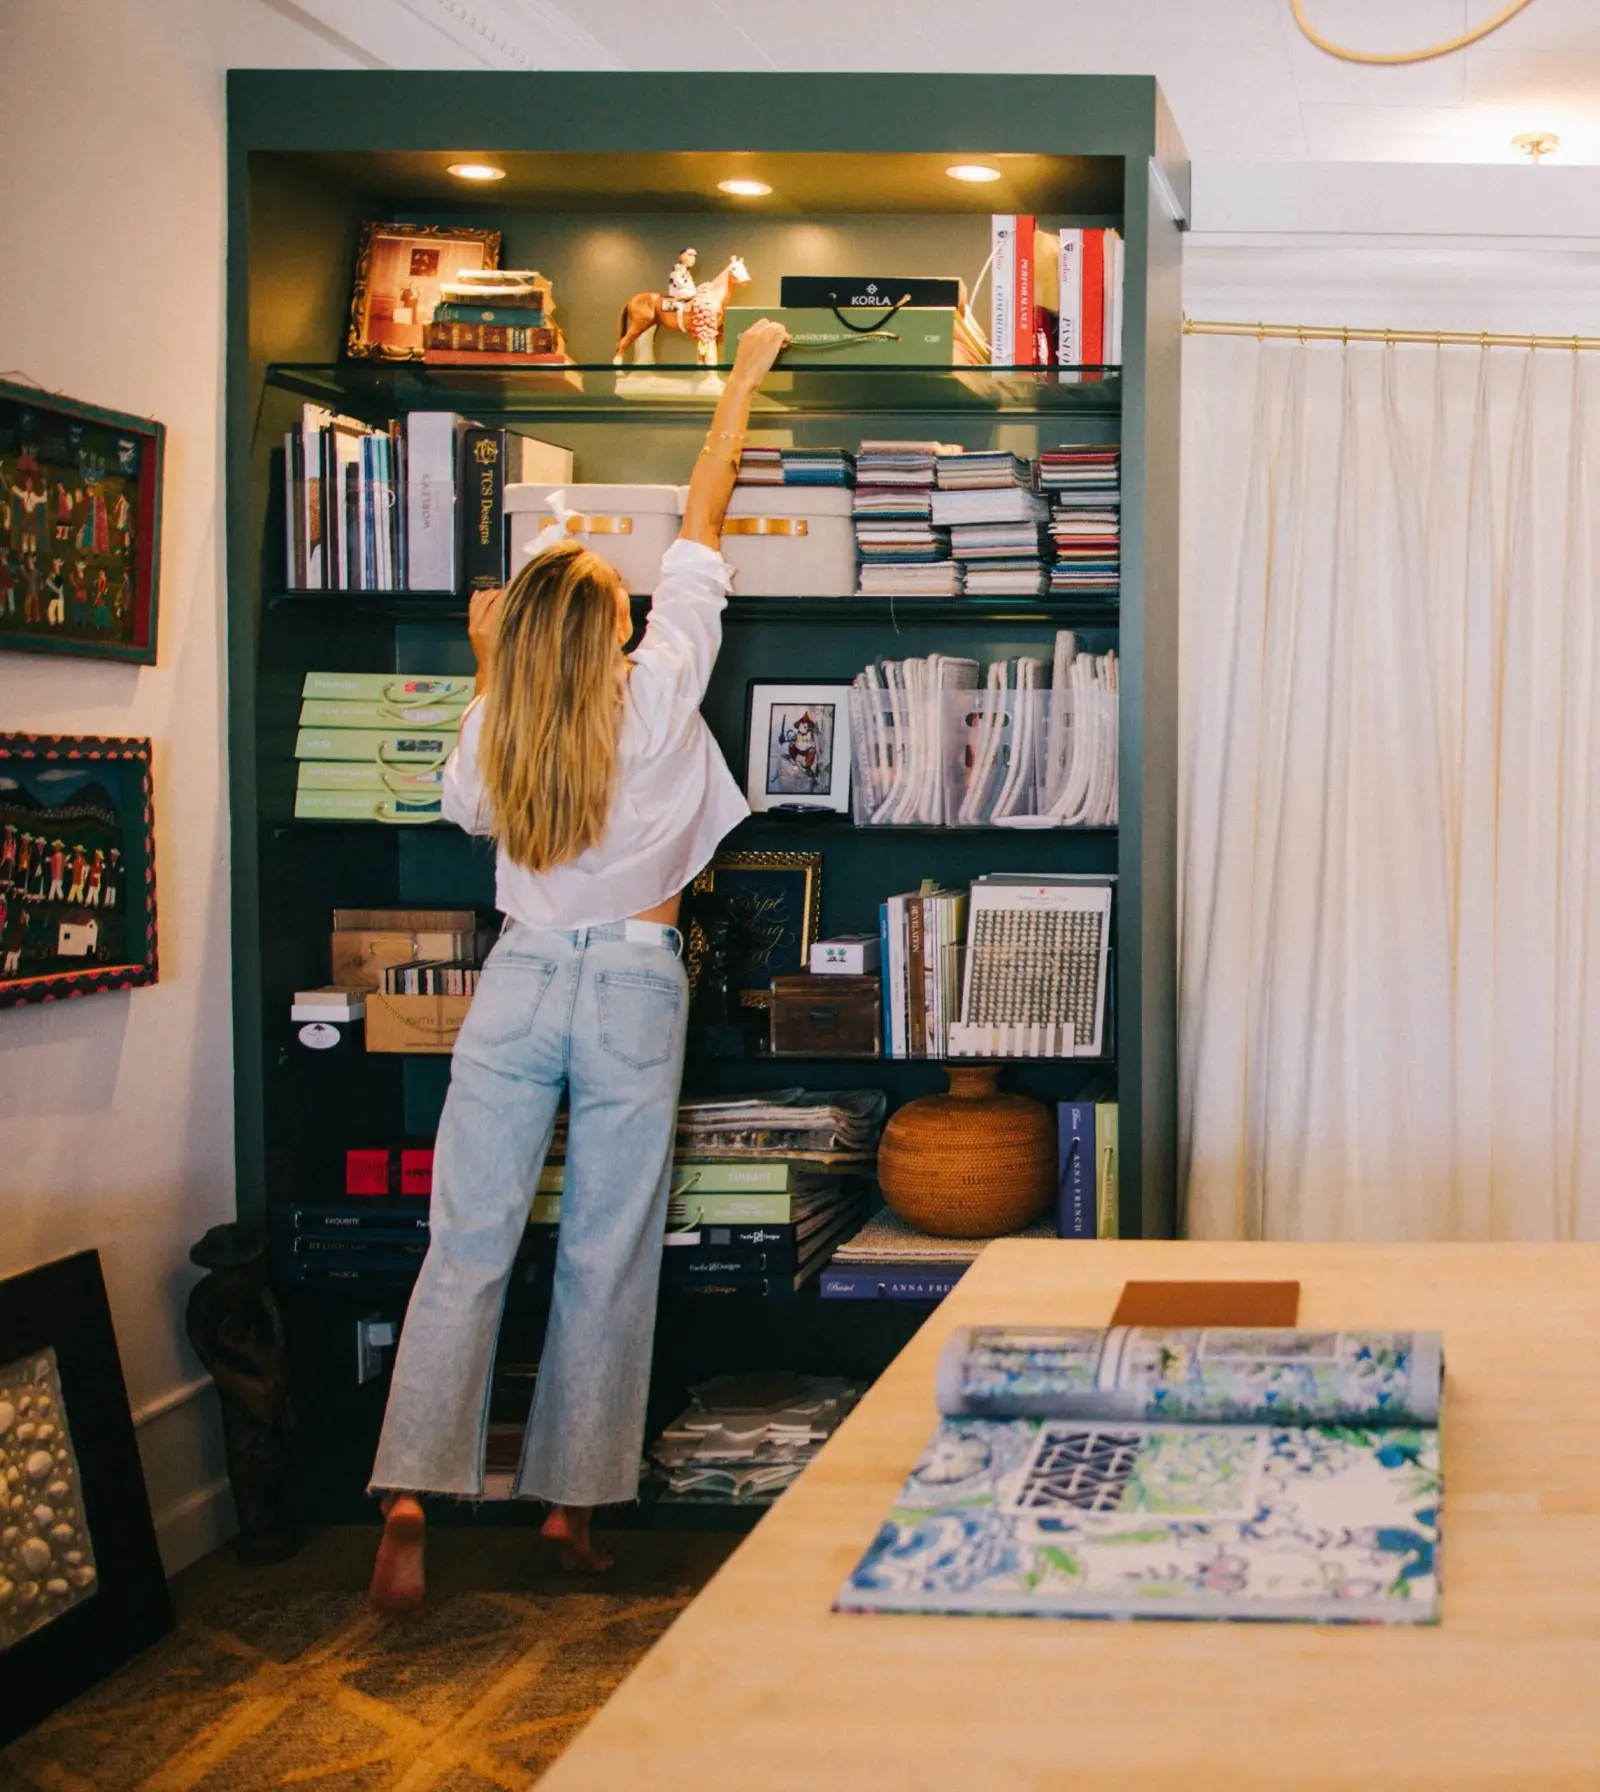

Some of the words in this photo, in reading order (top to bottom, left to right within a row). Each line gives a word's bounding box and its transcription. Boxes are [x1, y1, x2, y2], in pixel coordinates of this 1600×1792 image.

[851, 296, 891, 306] KORLA
[1020, 258, 1029, 329] PERFORMANCE
[481, 469, 493, 496] TCS
[479, 498, 492, 545] Designs
[911, 905, 919, 953] REVELATION
[1073, 1154, 1081, 1184] ANNA
[325, 1217, 360, 1226] EXQUISITE
[1074, 1188, 1082, 1232] FRENCH
[891, 1284, 924, 1292] ANNA
